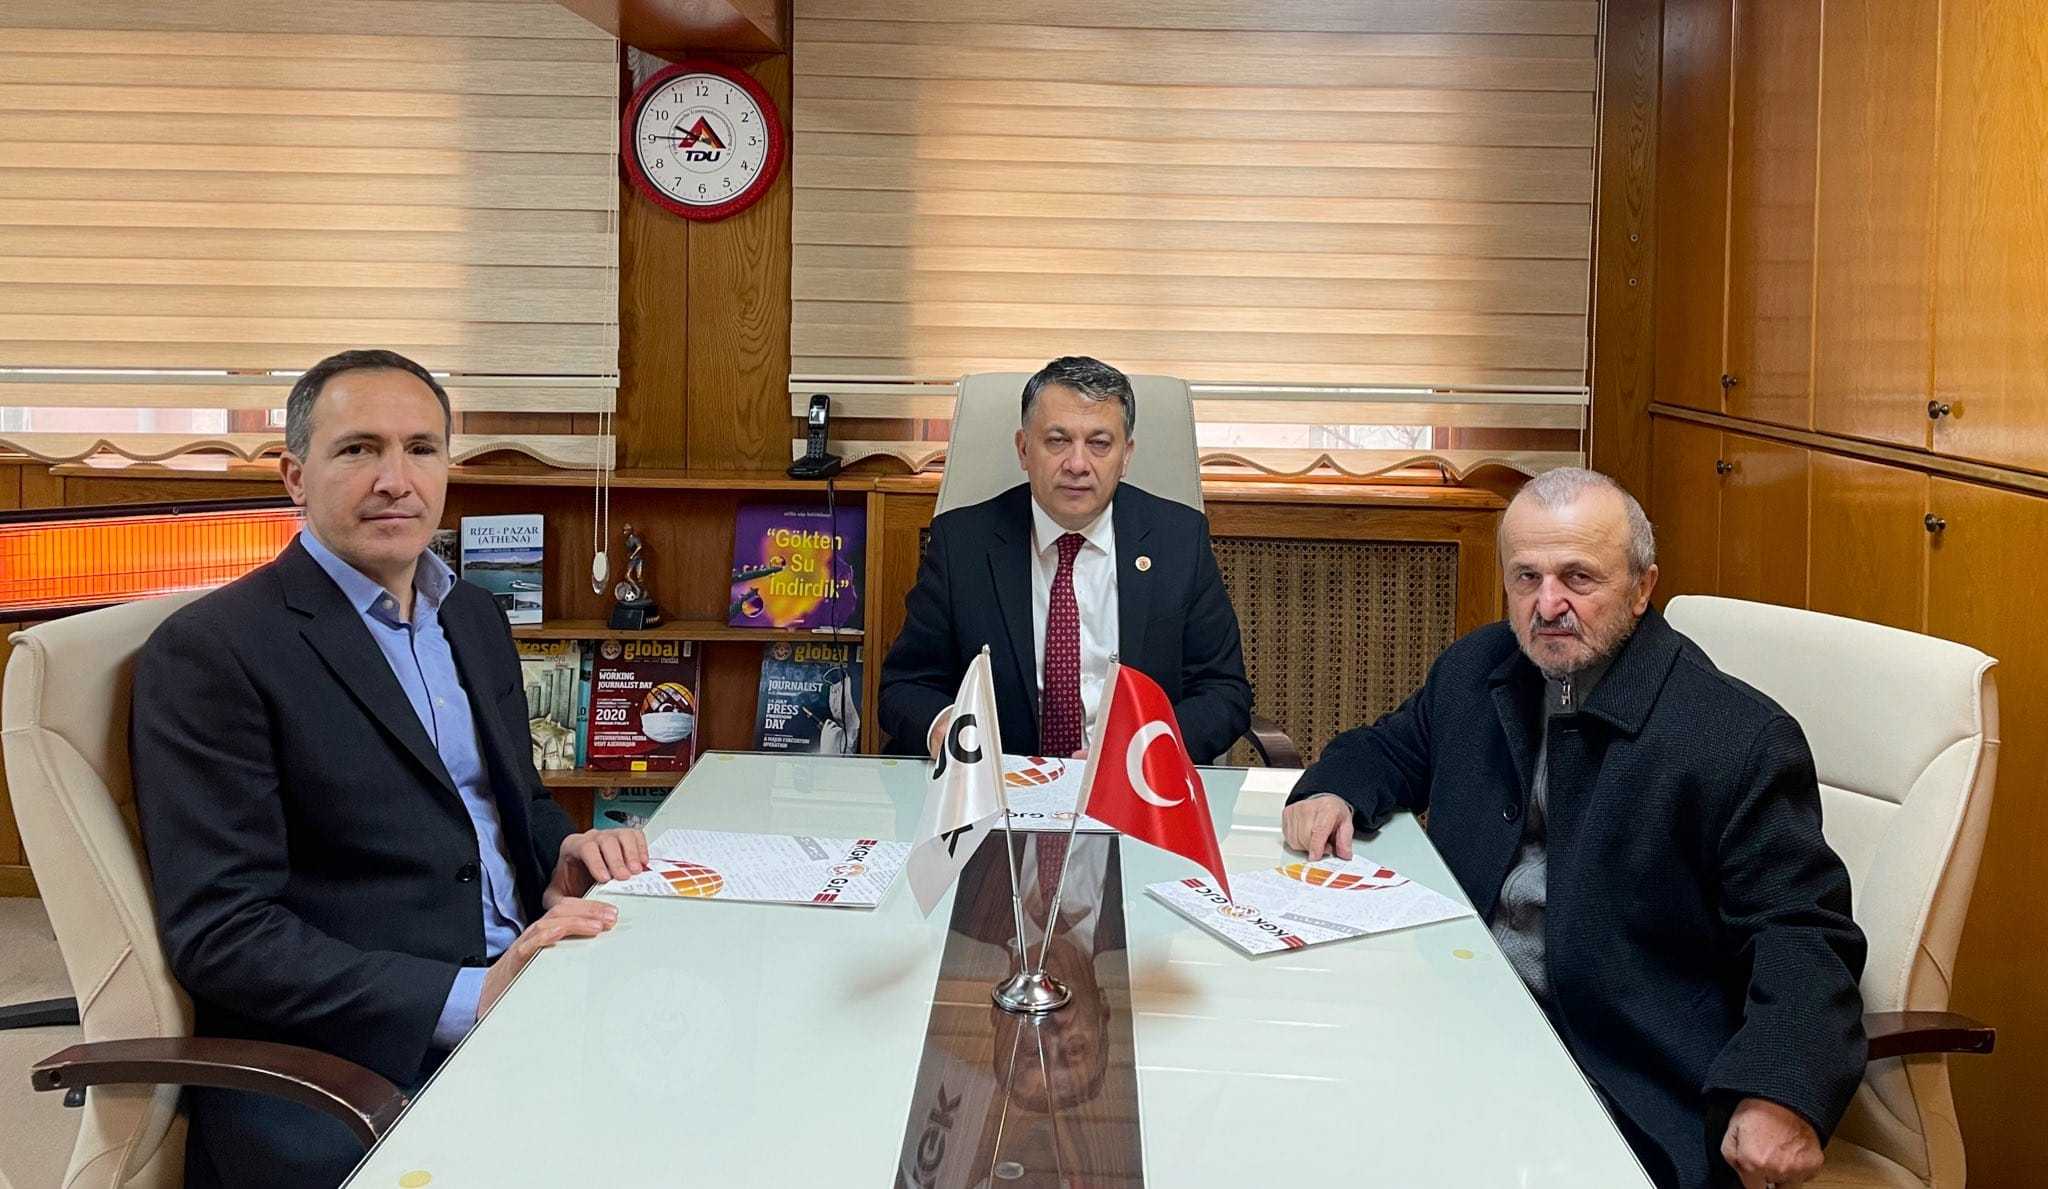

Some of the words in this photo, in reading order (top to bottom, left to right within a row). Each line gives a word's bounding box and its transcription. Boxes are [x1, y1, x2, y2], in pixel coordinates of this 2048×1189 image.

[695, 86, 709, 97] 12
[673, 93, 684, 104] 11
[725, 93, 730, 105] 1
[656, 110, 669, 121] 10
[740, 112, 749, 122] 2
[648, 134, 656, 144] 9
[748, 136, 757, 146] 3
[685, 150, 721, 162] TDU
[655, 159, 664, 169] 8
[740, 160, 748, 171] 4
[675, 177, 682, 188] 7
[723, 177, 731, 188] 5
[698, 184, 707, 194] 6
[503, 526, 539, 535] PAZAR
[478, 535, 530, 545] (ATHENA)
[791, 554, 814, 573] Su
[624, 640, 678, 660] global
[795, 642, 848, 662] global
[599, 672, 635, 680] WORKING
[768, 680, 823, 692] JOURNALIST
[596, 709, 627, 721] 2020
[767, 704, 799, 715] PRESS
[764, 719, 786, 730] DAY
[846, 846, 873, 862] KGK
[823, 878, 849, 893] GJC
[1195, 887, 1228, 904] GJC
[1246, 918, 1289, 937] KGK
